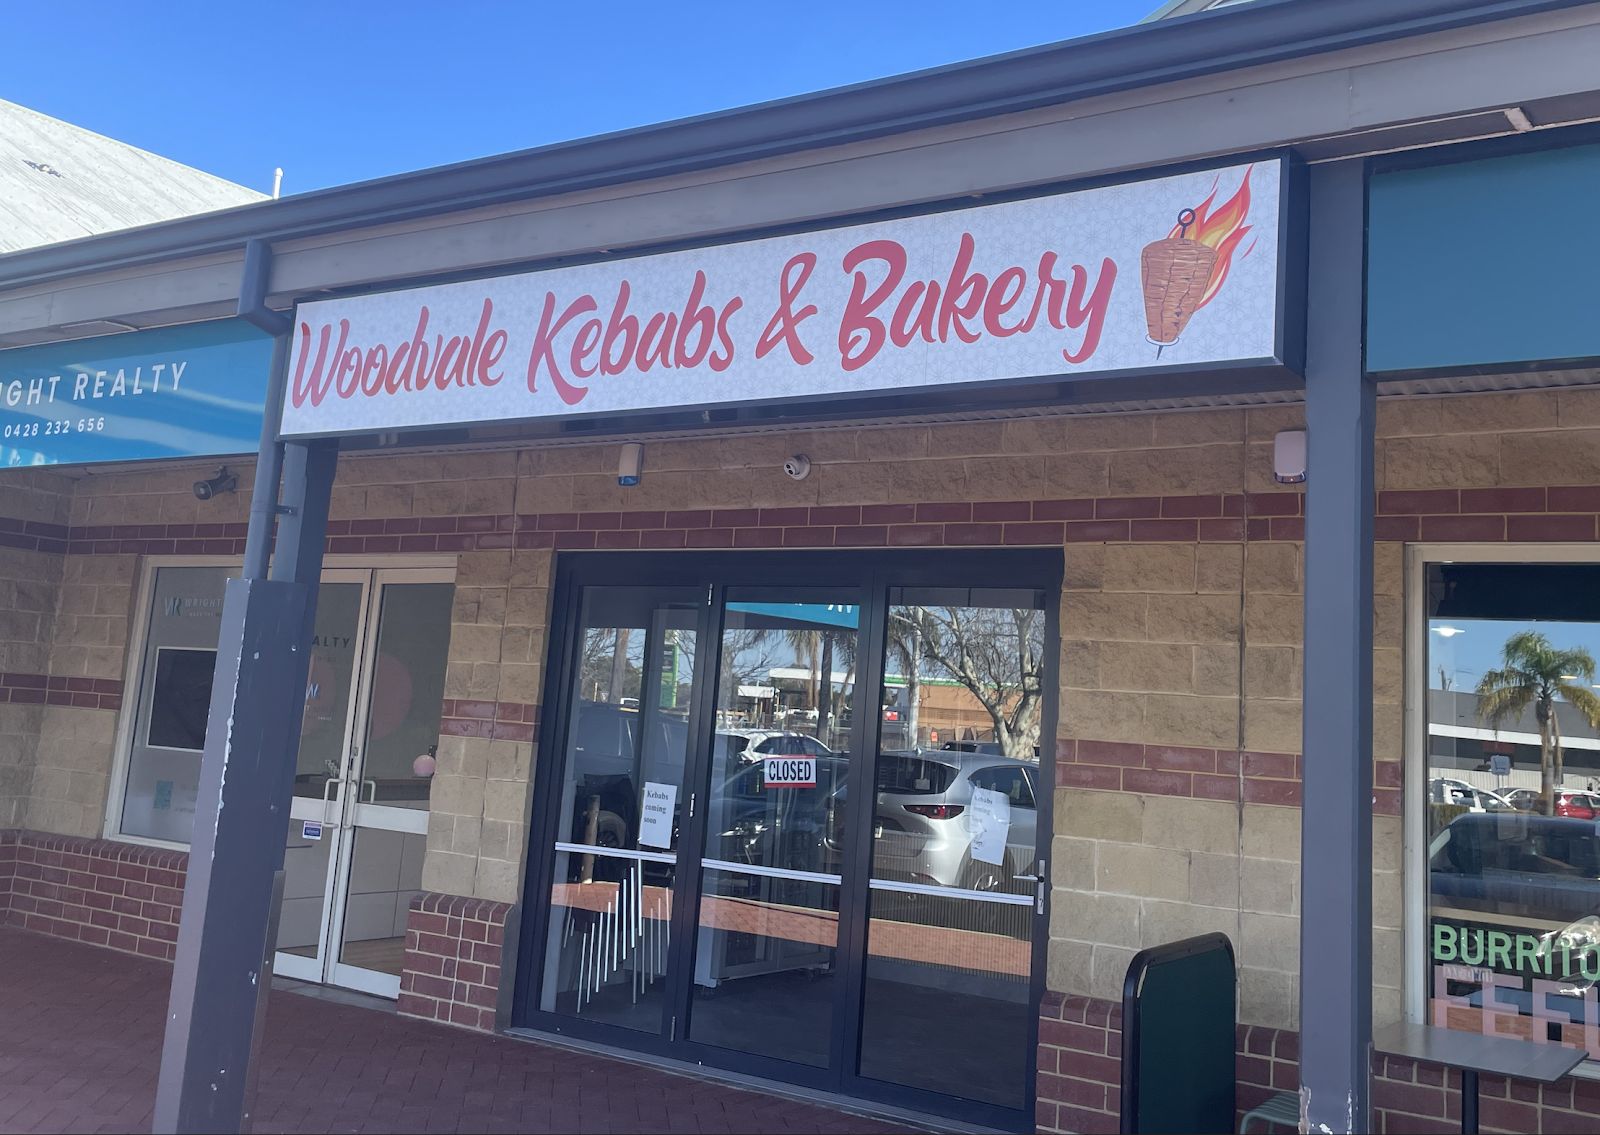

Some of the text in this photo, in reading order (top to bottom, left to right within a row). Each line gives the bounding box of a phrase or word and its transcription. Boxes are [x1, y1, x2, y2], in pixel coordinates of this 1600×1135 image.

[292, 232, 1118, 409] Woodvale Kebabs & Bakery
[73, 361, 188, 401] REALTY
[4, 417, 105, 438] 0428 232 656
[769, 760, 811, 781] CLOSED
[646, 790, 669, 801] Kebabs
[644, 804, 667, 815] coming
[643, 816, 657, 825] soon
